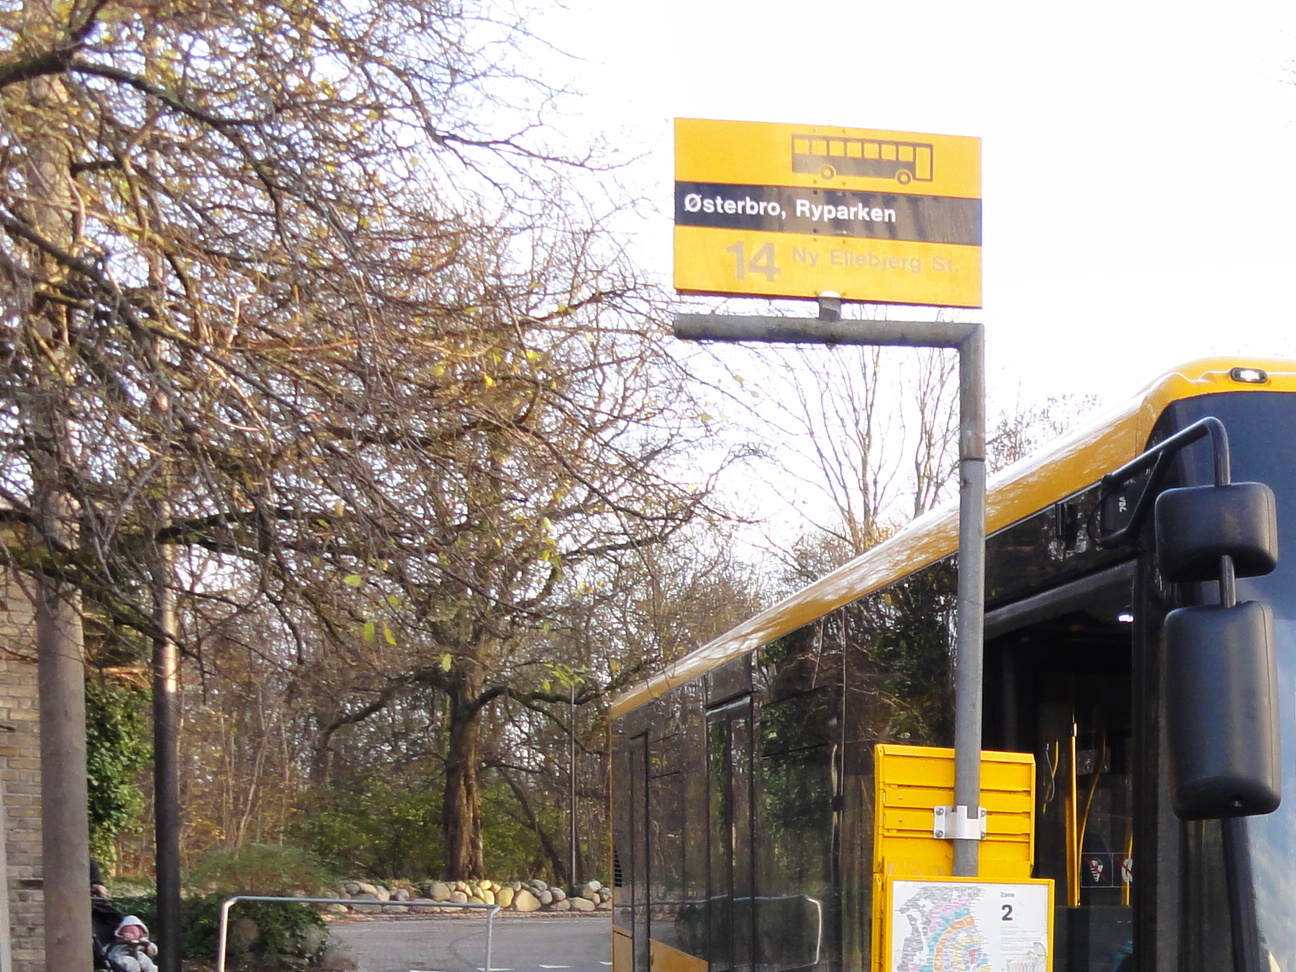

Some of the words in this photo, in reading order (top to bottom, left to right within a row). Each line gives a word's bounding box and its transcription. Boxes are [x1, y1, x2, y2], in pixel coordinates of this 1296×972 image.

[684, 193, 787, 220] Østerbro,
[796, 199, 897, 224] Ryparken
[725, 239, 782, 283] 14
[791, 247, 821, 268] Ny
[829, 249, 923, 275] Ellebjerg
[931, 255, 961, 274] St.
[1001, 904, 1014, 921] 2
